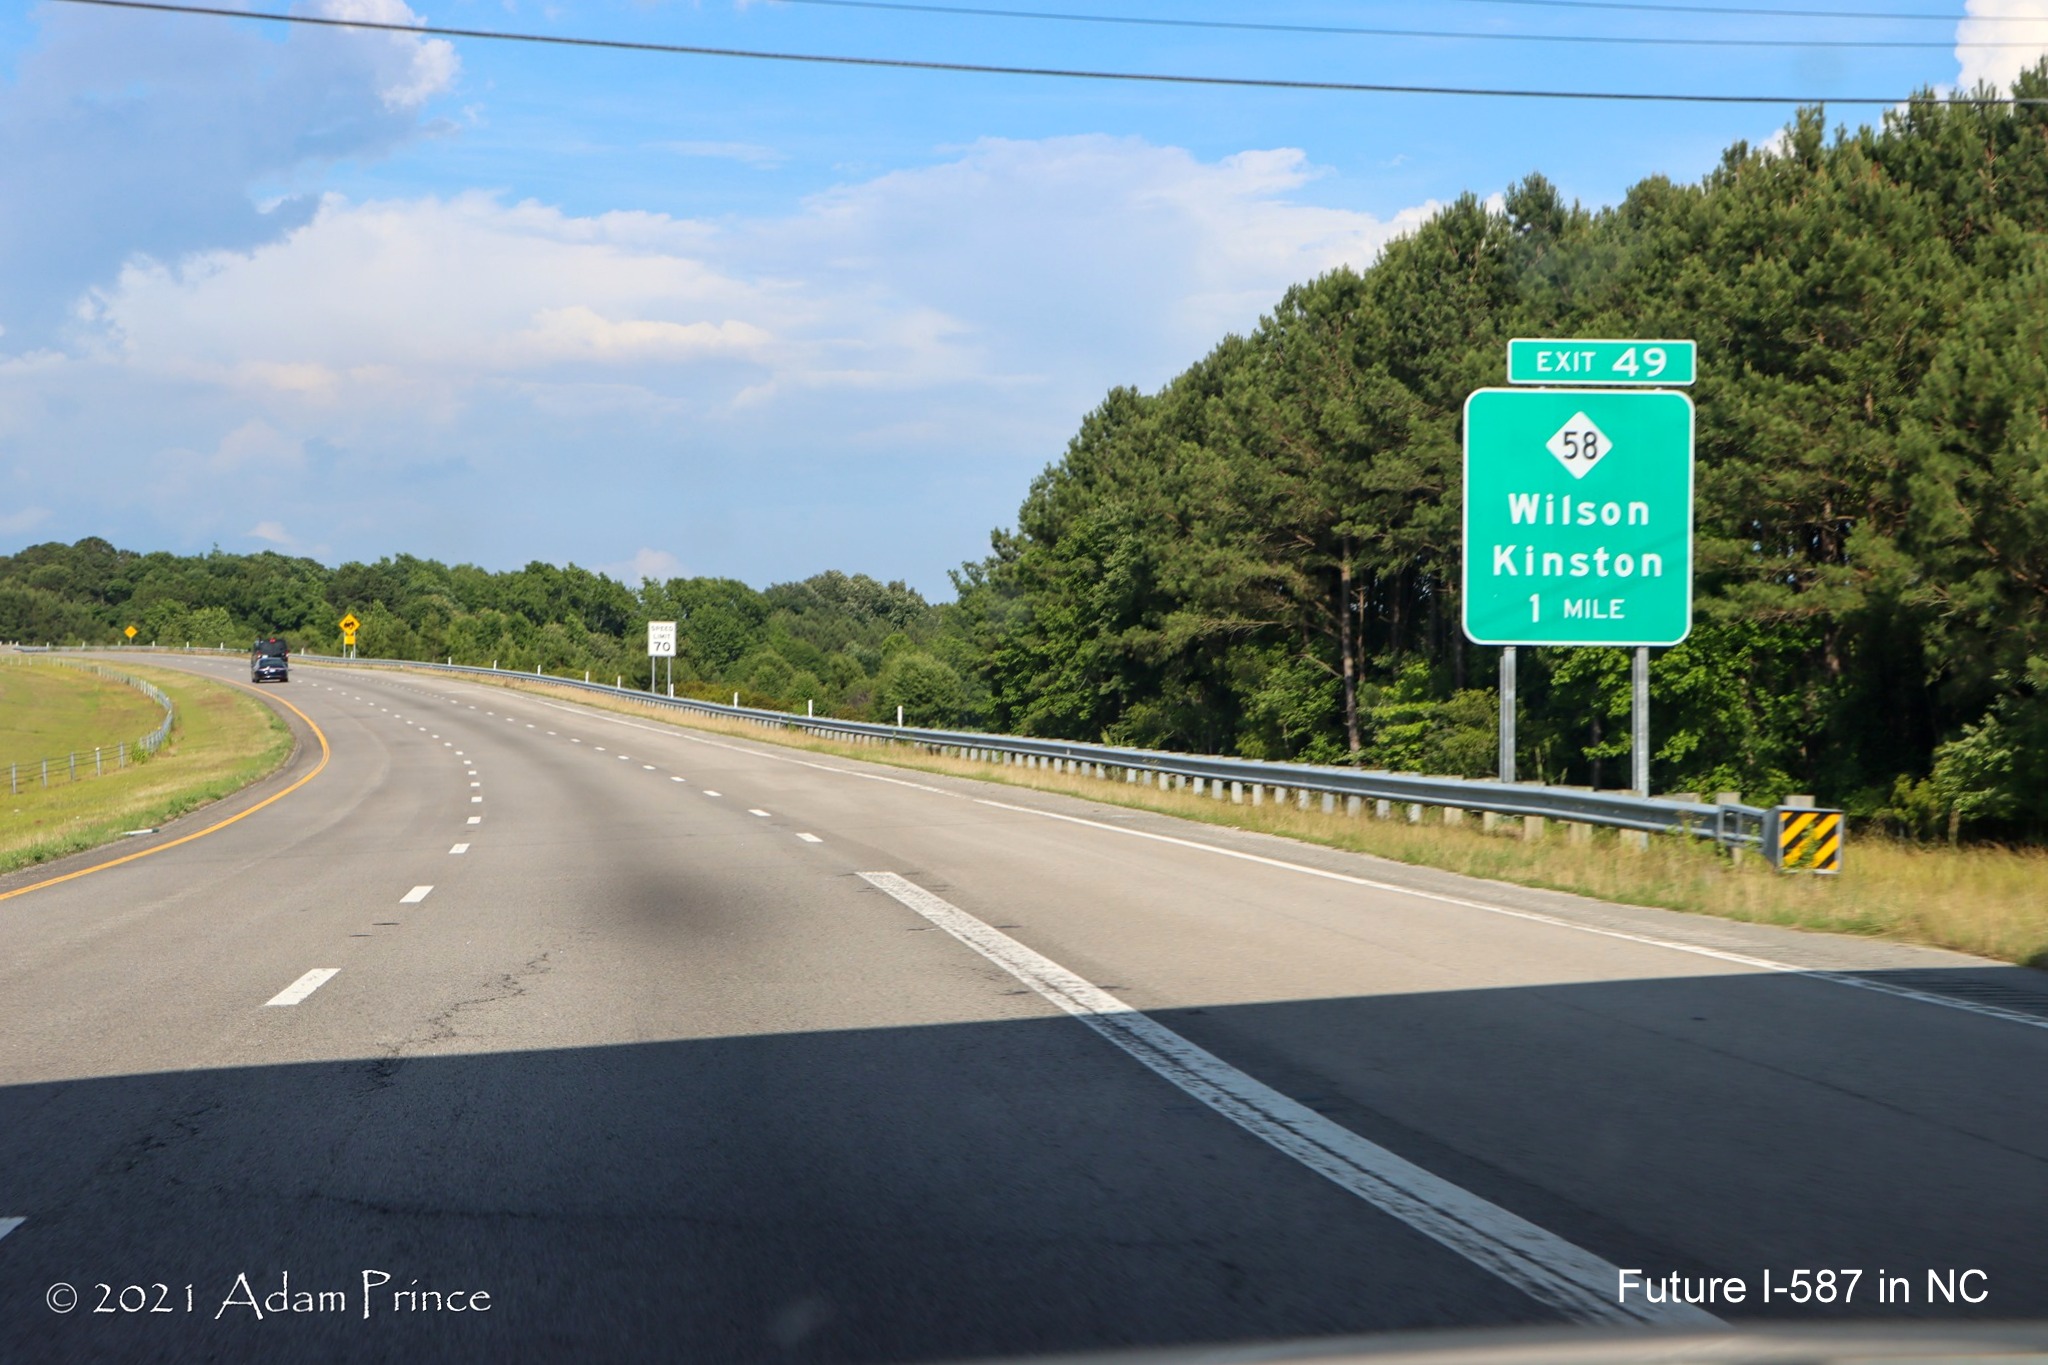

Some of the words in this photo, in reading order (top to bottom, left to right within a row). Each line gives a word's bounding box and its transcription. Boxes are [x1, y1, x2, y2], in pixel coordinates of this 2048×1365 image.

[1536, 351, 1596, 372] EXIT
[1611, 347, 1667, 377] 49
[1563, 431, 1598, 460] 58
[1508, 493, 1649, 526] Wilson
[1493, 545, 1662, 577] Kinston
[1529, 593, 1540, 623] 1
[1563, 598, 1625, 619] MILE
[653, 641, 671, 652] 70
